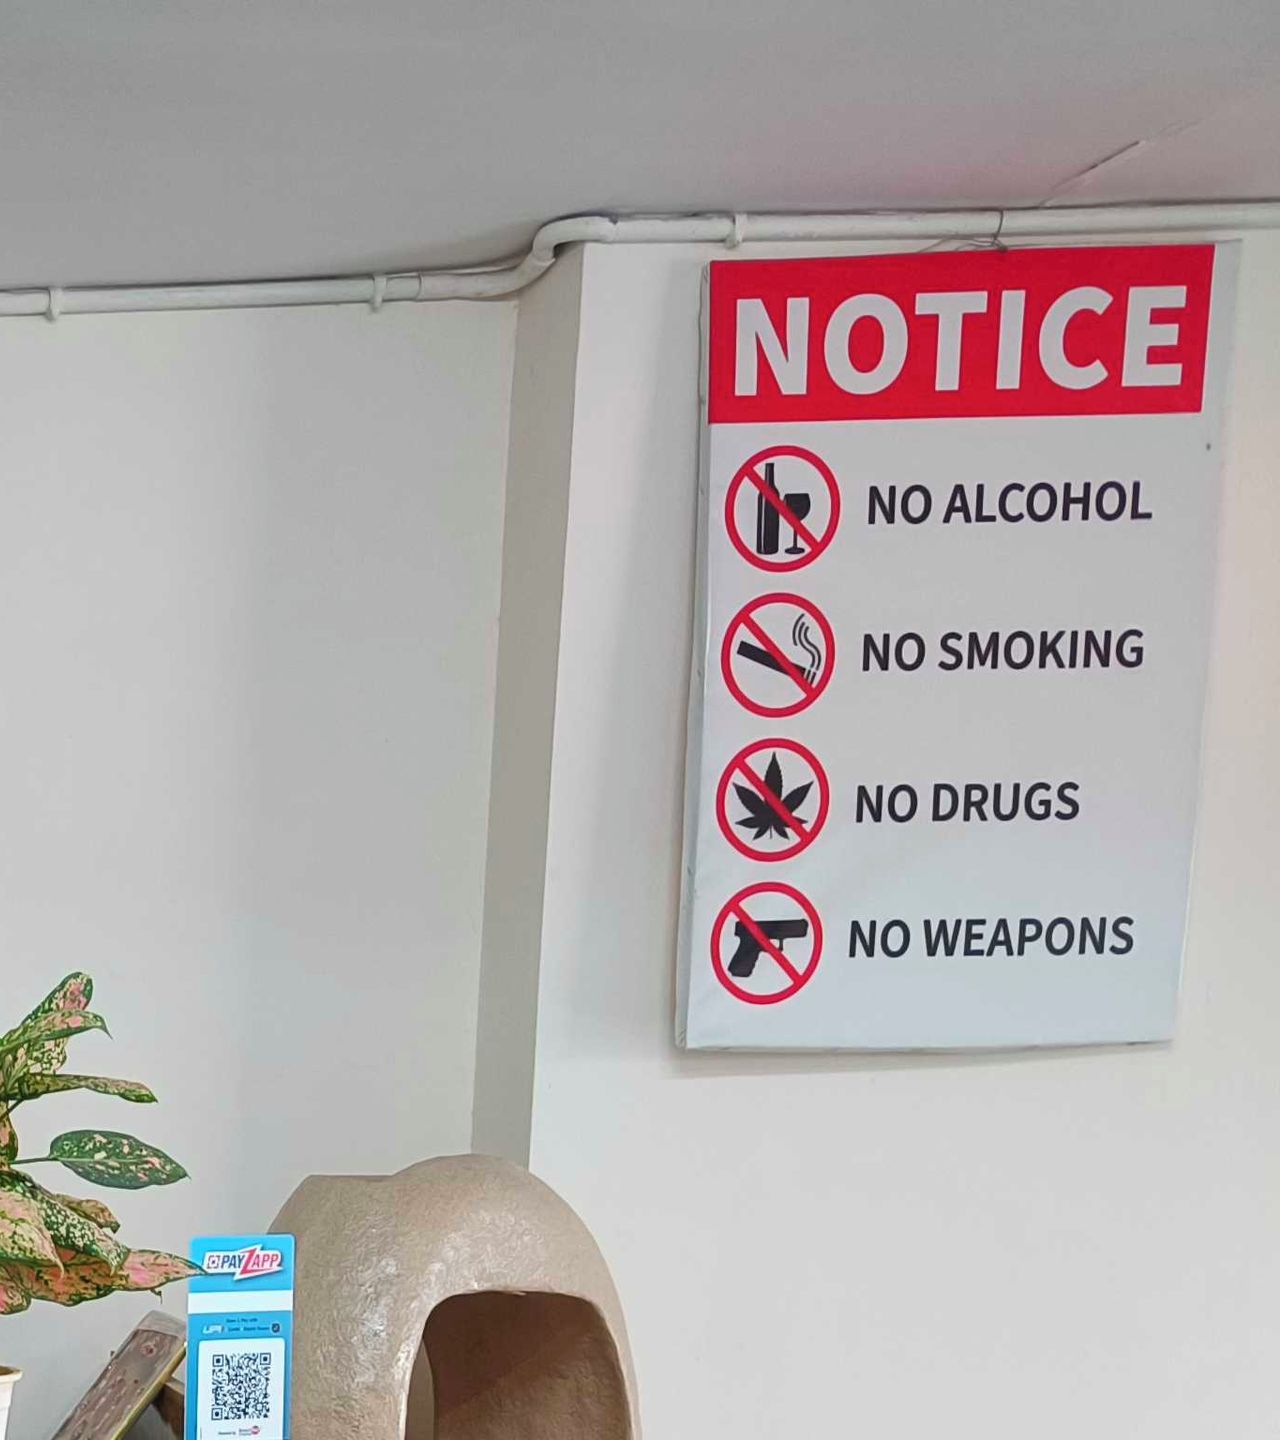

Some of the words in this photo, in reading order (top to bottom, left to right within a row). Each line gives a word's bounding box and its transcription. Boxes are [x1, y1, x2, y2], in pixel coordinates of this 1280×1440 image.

[734, 284, 1187, 398] NOTICE
[866, 484, 932, 526] NO
[942, 480, 1152, 524] ALCOHOL
[861, 632, 926, 673] NO
[937, 628, 1145, 672] SMOKING
[854, 783, 919, 823] NO
[930, 780, 1080, 822] DRUGS
[847, 919, 913, 959] NO
[923, 915, 1134, 958] WEAPONS
[221, 1248, 280, 1275] PAYZAPP
